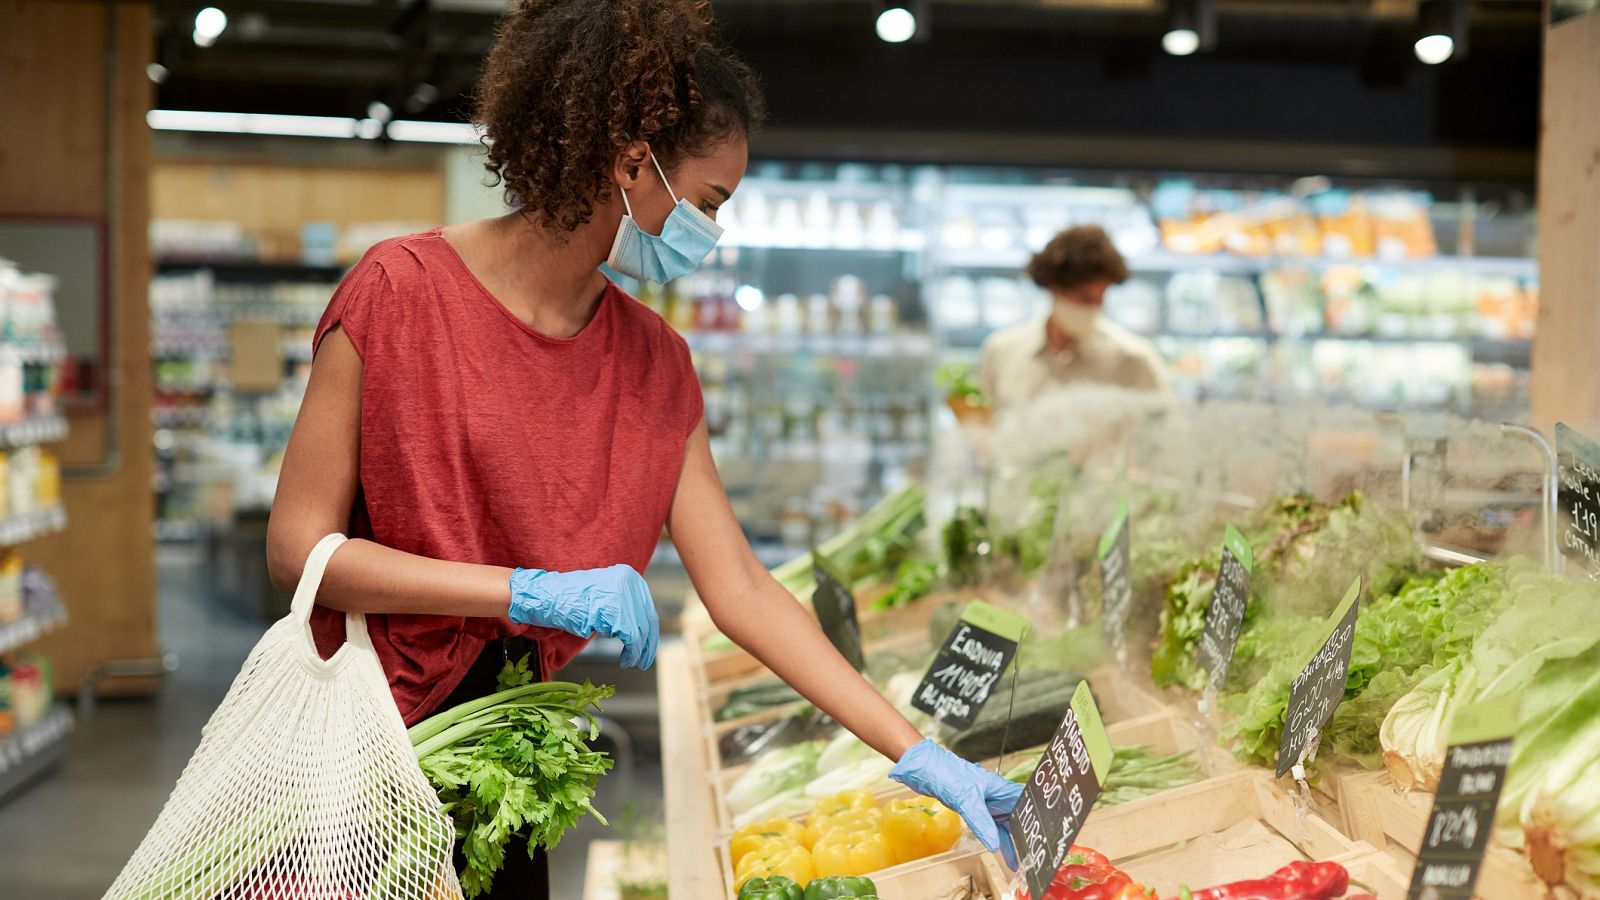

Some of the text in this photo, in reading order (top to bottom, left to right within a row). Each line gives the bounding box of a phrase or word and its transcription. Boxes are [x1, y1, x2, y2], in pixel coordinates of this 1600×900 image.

[1572, 453, 1600, 483] Lech
[1323, 624, 1352, 668] ROJO
[1290, 677, 1325, 733] 6'20
[1034, 759, 1062, 810] 6'20
[1051, 735, 1084, 817] VERDE ECO
[1018, 798, 1047, 876] MURCIA
